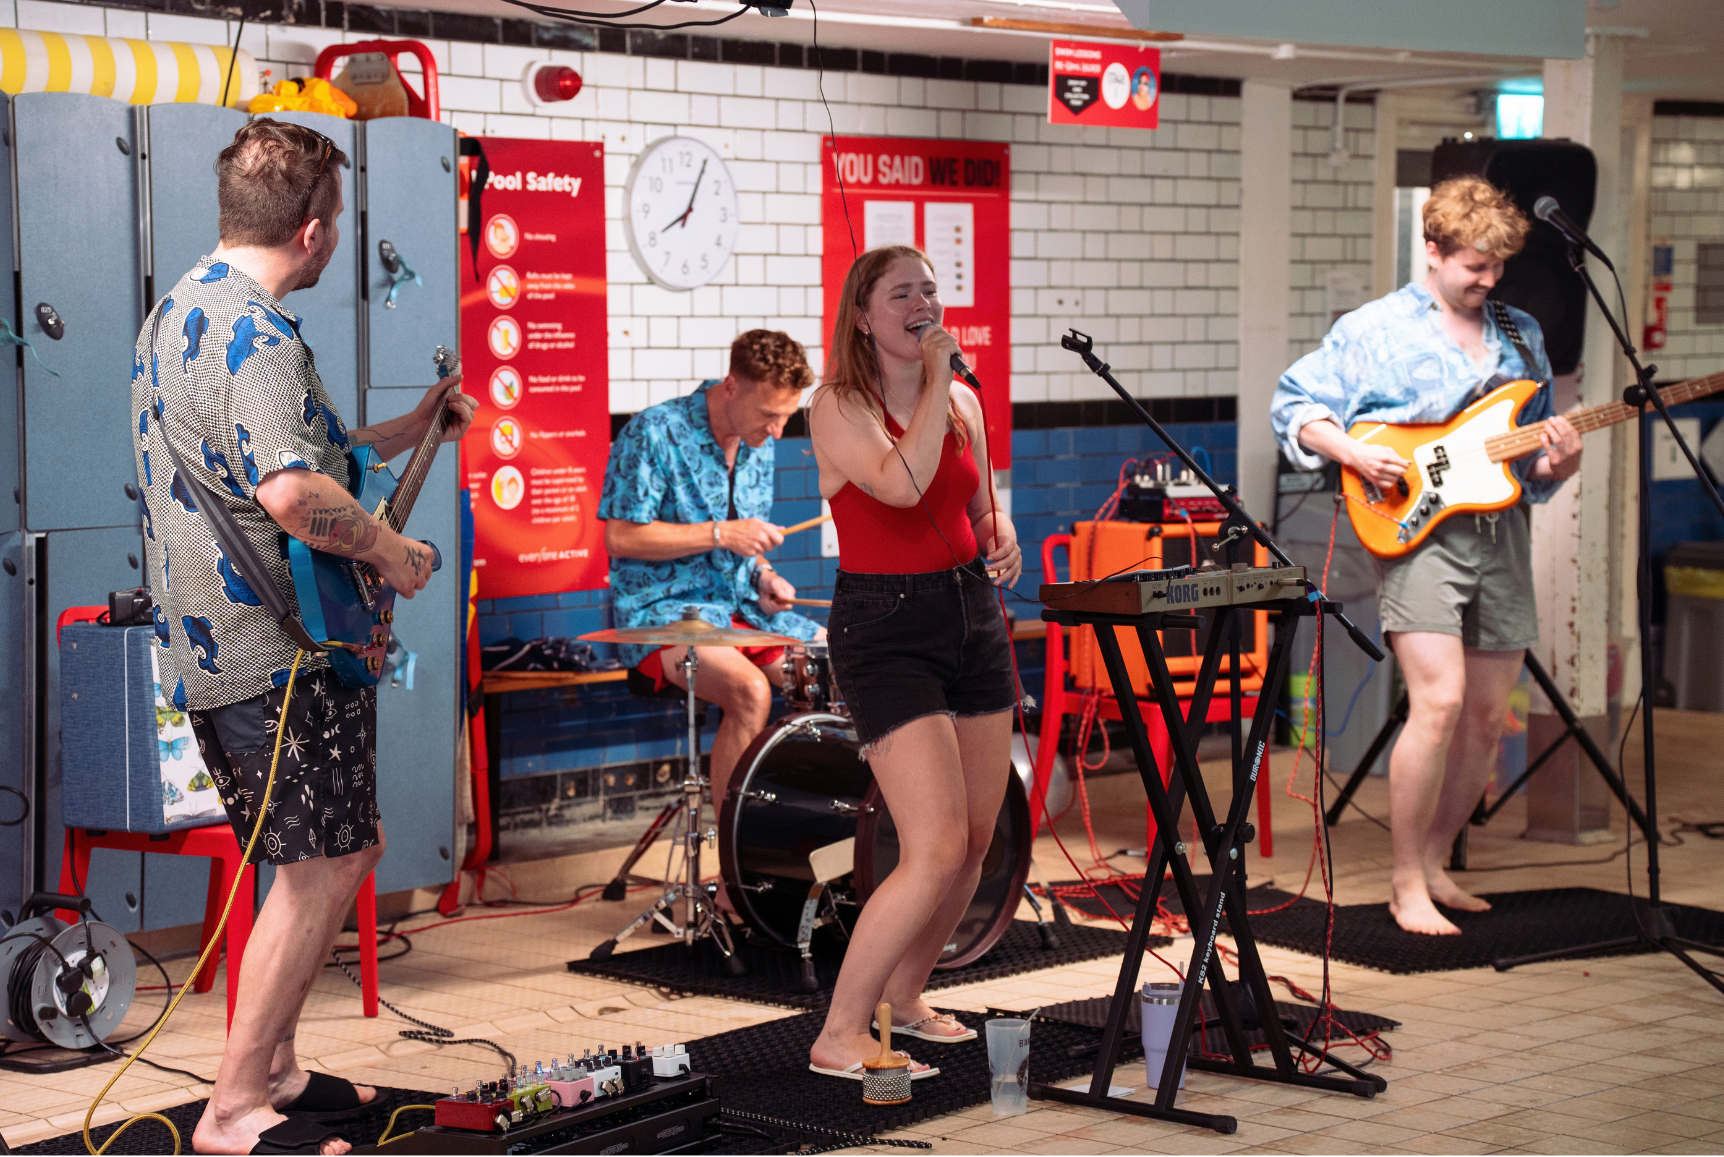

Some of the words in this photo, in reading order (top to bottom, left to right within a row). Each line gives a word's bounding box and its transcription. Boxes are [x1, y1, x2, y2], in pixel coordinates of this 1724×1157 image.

[661, 157, 674, 173] 11
[679, 151, 693, 167] 12
[832, 153, 873, 184] YOU
[878, 154, 924, 185] SAID
[929, 157, 958, 187] WE
[964, 159, 1001, 187] DID!
[484, 169, 522, 190] Pool
[526, 171, 582, 197] Safety
[649, 176, 664, 192] 10
[713, 179, 722, 195] 2
[642, 203, 650, 218] 9
[720, 206, 728, 222] 3
[648, 231, 657, 247] 8
[714, 234, 722, 247] 4
[663, 251, 671, 267] 7
[681, 259, 690, 275] 6
[701, 253, 709, 269] 5
[961, 326, 992, 346] LOVE
[1166, 583, 1199, 604] KORG
[1197, 964, 1207, 985] KS2
[1203, 919, 1219, 963] keyboard
[1215, 891, 1226, 919] stand
